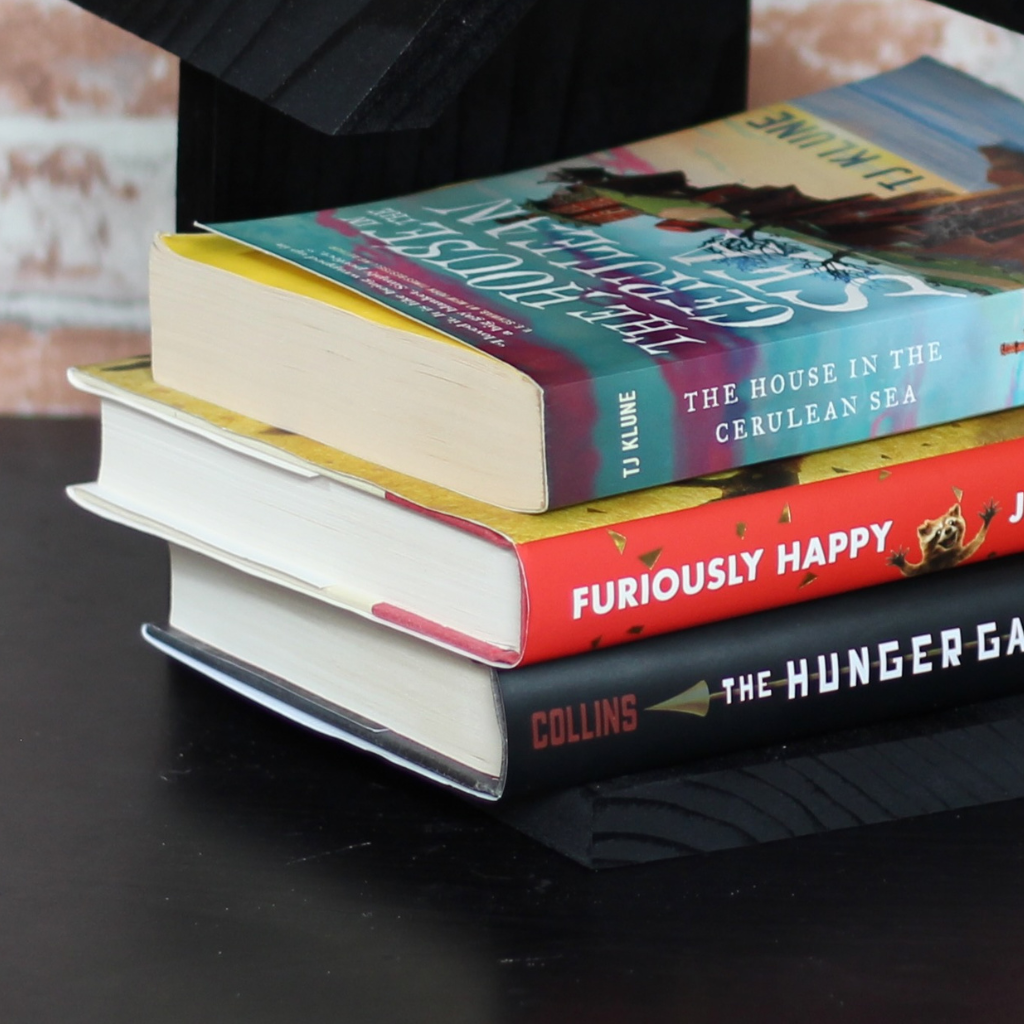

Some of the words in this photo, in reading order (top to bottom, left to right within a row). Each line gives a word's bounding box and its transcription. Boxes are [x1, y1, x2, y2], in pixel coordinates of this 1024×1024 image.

[746, 111, 881, 168] KLUNE
[862, 166, 924, 191] TJ
[361, 221, 622, 310] HOUSE
[421, 198, 794, 327] CERULEAN
[670, 230, 967, 312] SEA
[566, 304, 706, 355] THE
[684, 383, 739, 413] THE
[750, 363, 838, 400] HOUSE
[850, 355, 877, 379] IN
[890, 341, 943, 365] THE
[619, 390, 639, 452] KLUNE
[715, 397, 858, 444] CERULEAN
[870, 384, 917, 411] SEA
[622, 457, 640, 479] TJ
[572, 548, 764, 620] FURIOUSLY
[777, 520, 893, 575] HAPPY
[722, 670, 772, 705] THE
[787, 628, 962, 699] HUNGER
[531, 693, 638, 750] COLLINS
